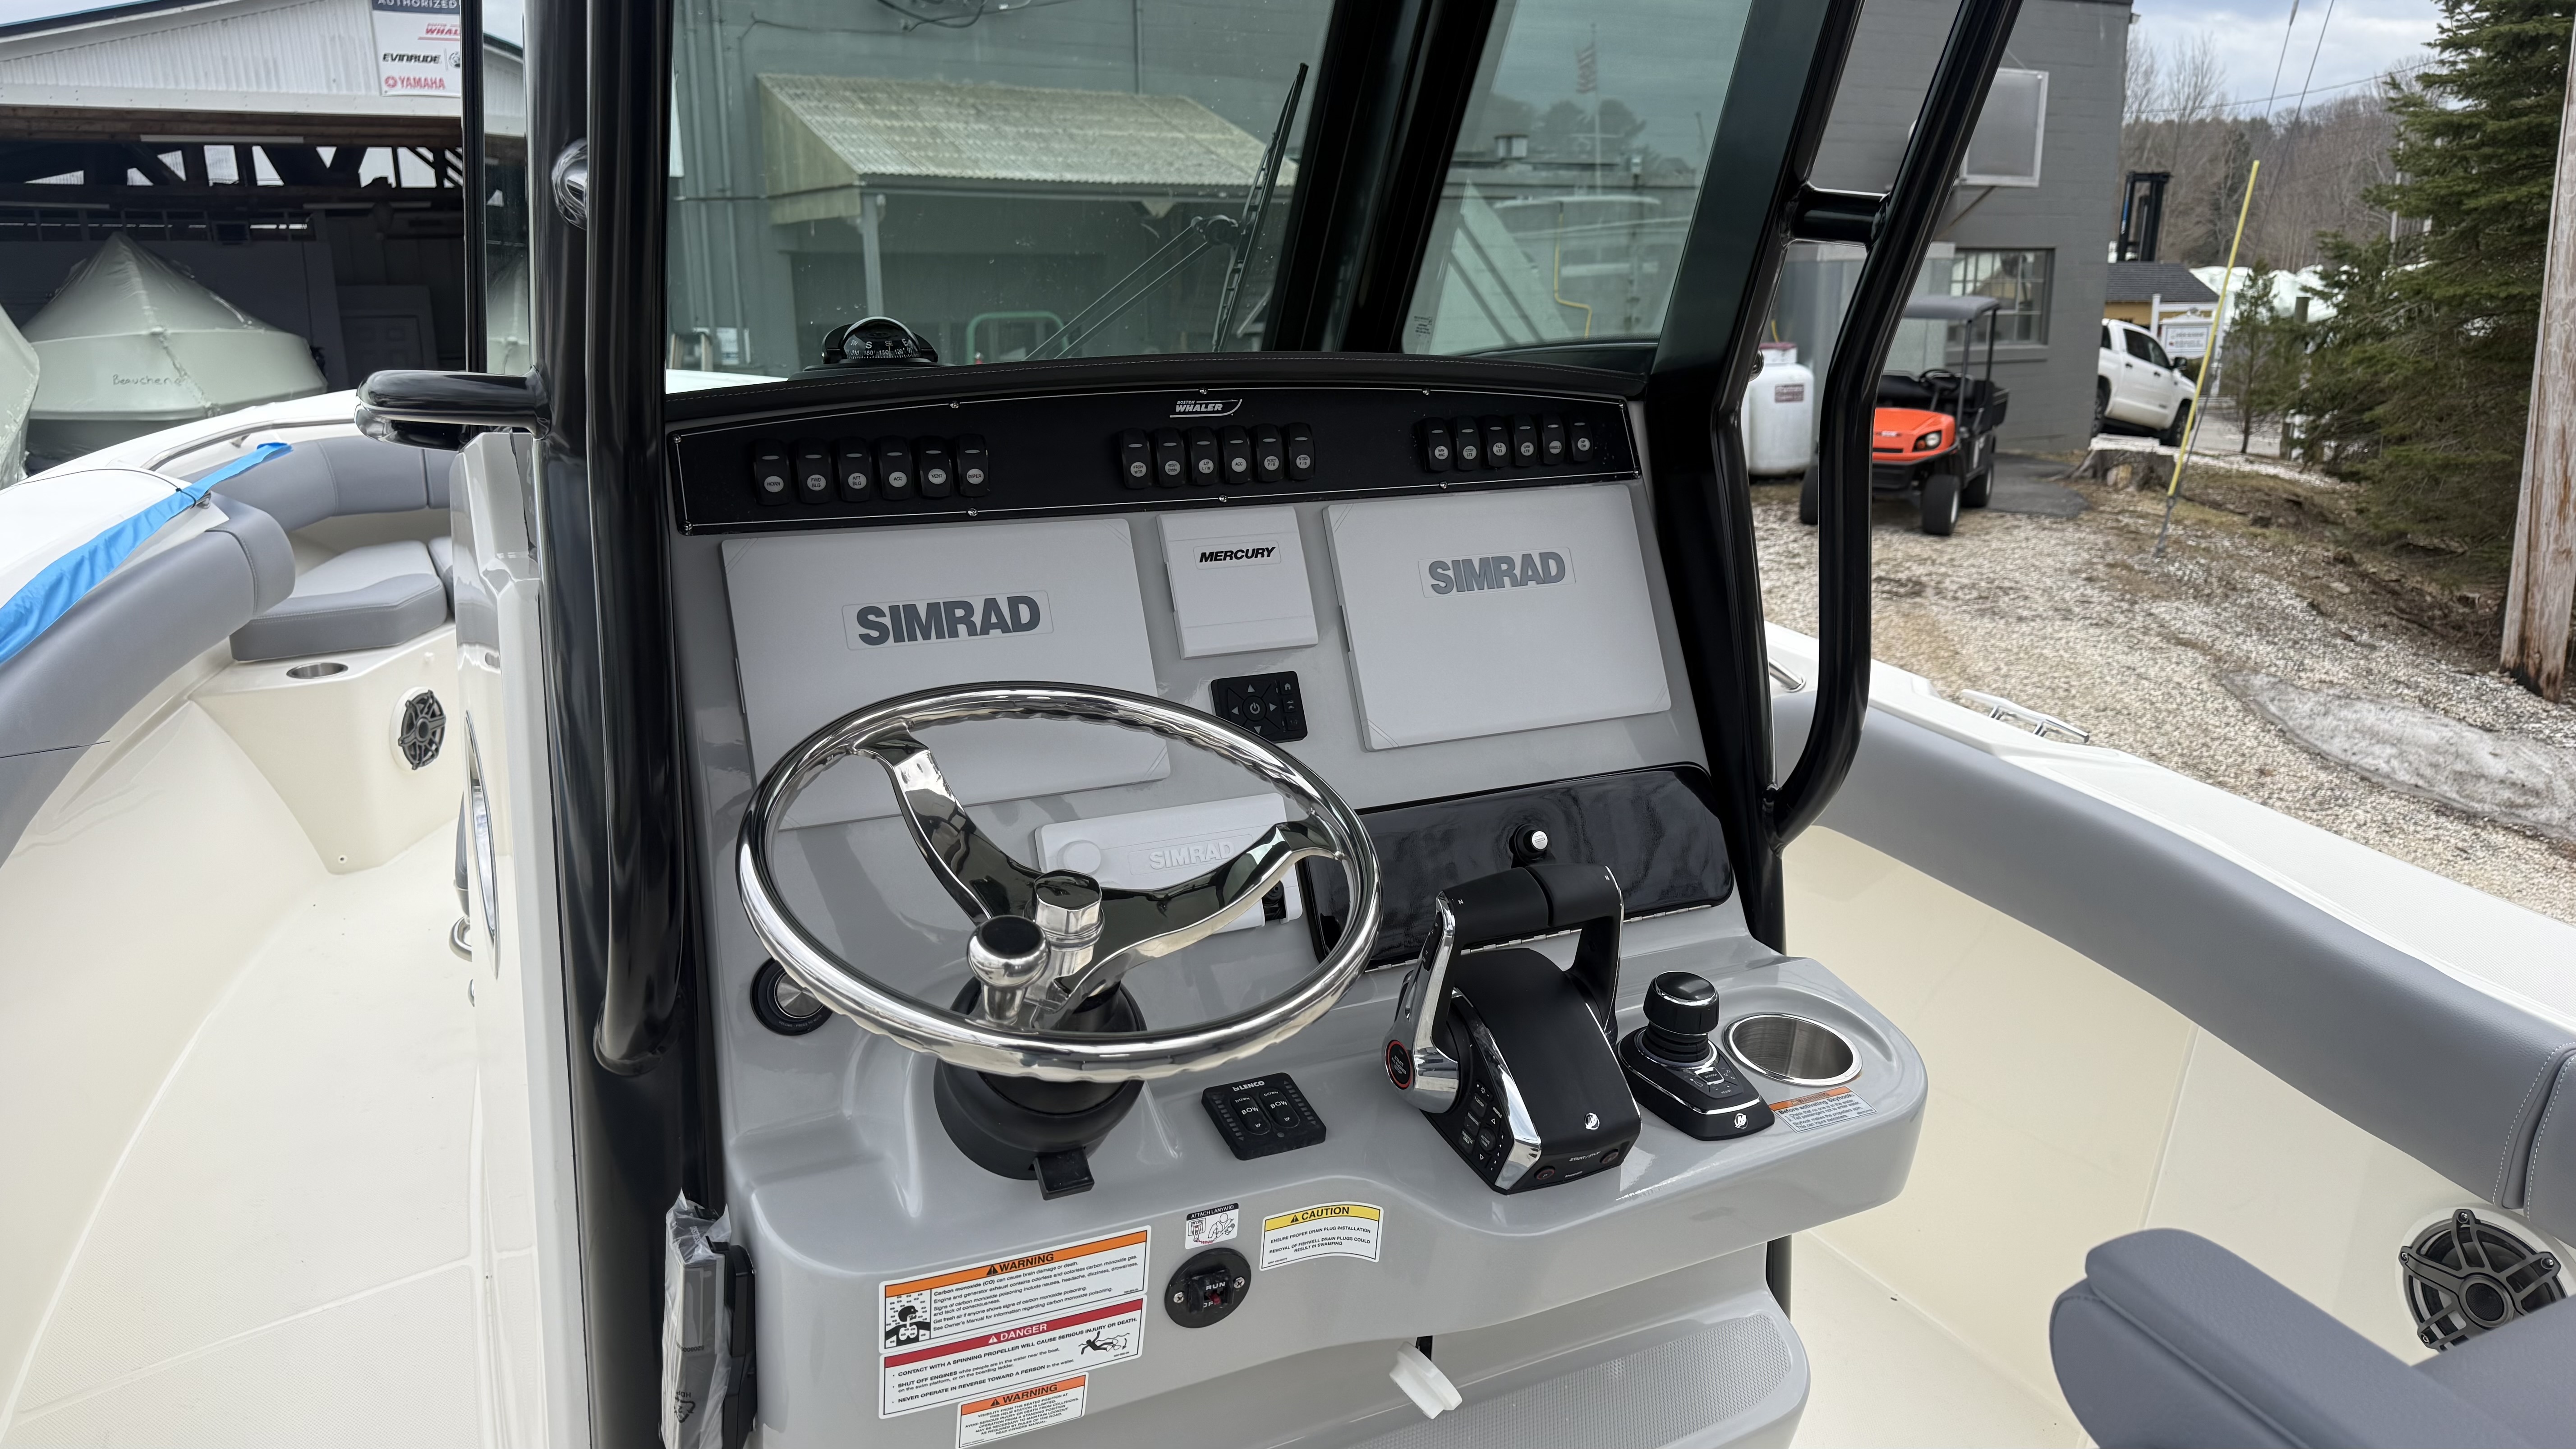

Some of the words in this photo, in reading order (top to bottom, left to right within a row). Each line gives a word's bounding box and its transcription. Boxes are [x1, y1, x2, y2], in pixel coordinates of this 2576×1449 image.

[378, 0, 457, 8] AUTHORIZED
[382, 53, 442, 64] EVINRUDE
[400, 76, 446, 89] YAMAHA
[865, 341, 873, 349] S
[1176, 404, 1223, 412] WHALER
[1199, 547, 1276, 563] MERCURY
[1429, 552, 1566, 595] SIMRAD
[856, 595, 1041, 646] SIMRAD
[1150, 841, 1235, 870] SIMRAD
[1239, 1081, 1265, 1090] LENCO
[1270, 1100, 1288, 1109] BOW
[1778, 1106, 1800, 1115] Before
[1799, 1099, 1827, 1110] activating
[1826, 1093, 1855, 1103] Skyhook:
[1798, 1092, 1830, 1103] WARNING
[1241, 1106, 1259, 1115] BOW
[1191, 1210, 1210, 1219] ATTACH
[1211, 1204, 1234, 1214] LANYARD
[1302, 1206, 1350, 1221] CAUTION
[1270, 1235, 1289, 1244] ENSURE
[1290, 1231, 1308, 1239] PROPER
[1337, 1225, 1371, 1234] INSTALLATION
[1269, 1245, 1290, 1254] REMOVAL
[1298, 1238, 1320, 1247] FISHWELL
[1294, 1244, 1311, 1253] RESULT
[999, 1253, 1054, 1272] WARNING
[964, 1289, 988, 1298] generator
[1031, 1274, 1052, 1283] odorless
[1104, 1257, 1127, 1266] monoxide
[973, 1294, 998, 1302] monoxide
[998, 1288, 1023, 1297] poisoning
[1062, 1274, 1086, 1283] headache,
[1087, 1269, 1110, 1277] dizziness,
[1111, 1262, 1138, 1271] drowsiness,
[955, 1283, 981, 1292] monoxide
[1206, 1281, 1226, 1291] RUN
[1000, 1324, 1047, 1341] DANGER
[898, 1366, 928, 1376] CONTACT
[952, 1354, 982, 1365] SPINNING
[984, 1345, 1019, 1357] PROPELLER
[1036, 1336, 1057, 1345] CAUSE
[1058, 1330, 1084, 1340] SERIOUS
[1085, 1325, 1106, 1334] INJURY
[975, 1367, 997, 1375] boarding
[898, 1380, 915, 1388] SHUT
[930, 1371, 957, 1381] ENGINES
[898, 1394, 919, 1403] NEVER
[920, 1388, 949, 1398] OPERATE
[958, 1379, 986, 1389] REVERSE
[988, 1373, 1014, 1382] TOWARD
[1021, 1365, 1045, 1375] PERSON
[1003, 1384, 1058, 1403] WARNING
